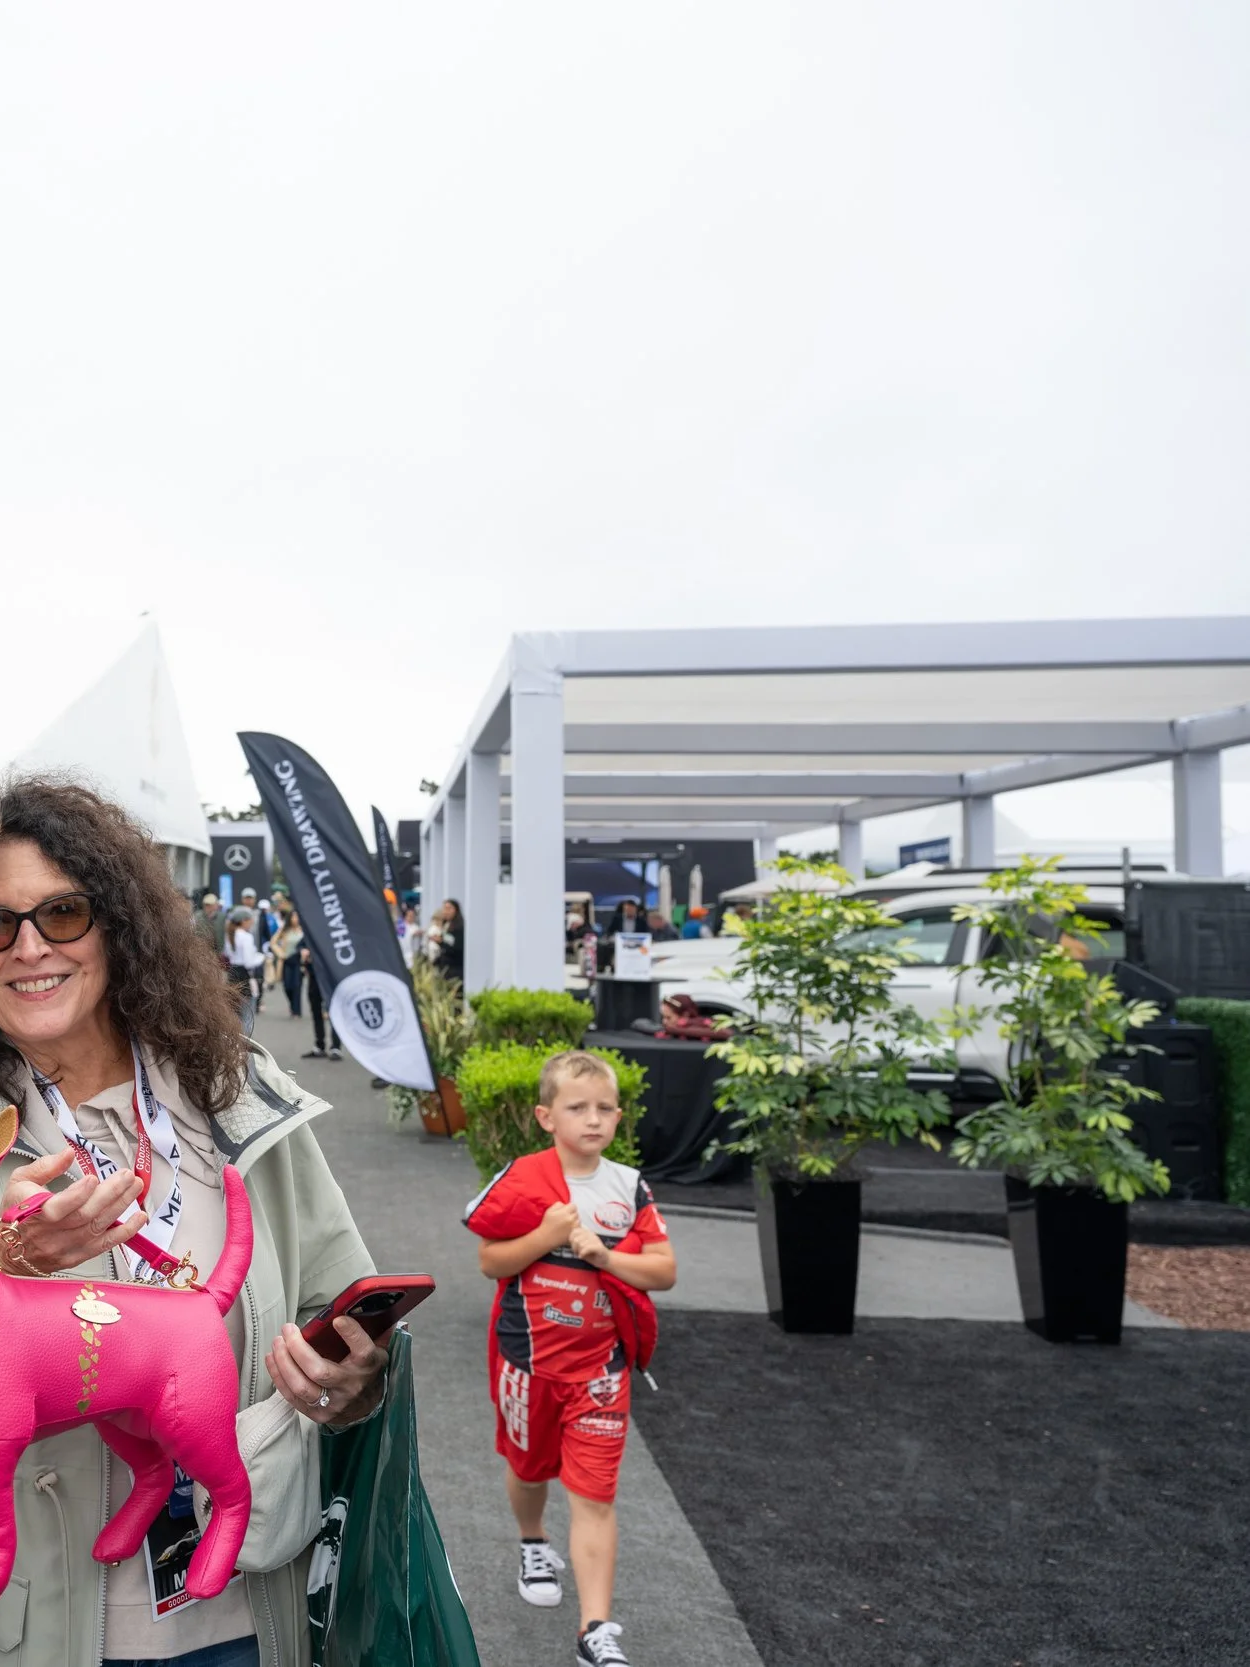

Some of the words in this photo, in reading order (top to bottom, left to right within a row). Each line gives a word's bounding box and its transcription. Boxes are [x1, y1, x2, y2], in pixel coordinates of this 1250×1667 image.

[274, 759, 327, 866] DRAWING
[313, 866, 356, 966] CHARITY
[136, 1132, 145, 1171] GOODING
[168, 1593, 192, 1608] GOODI
